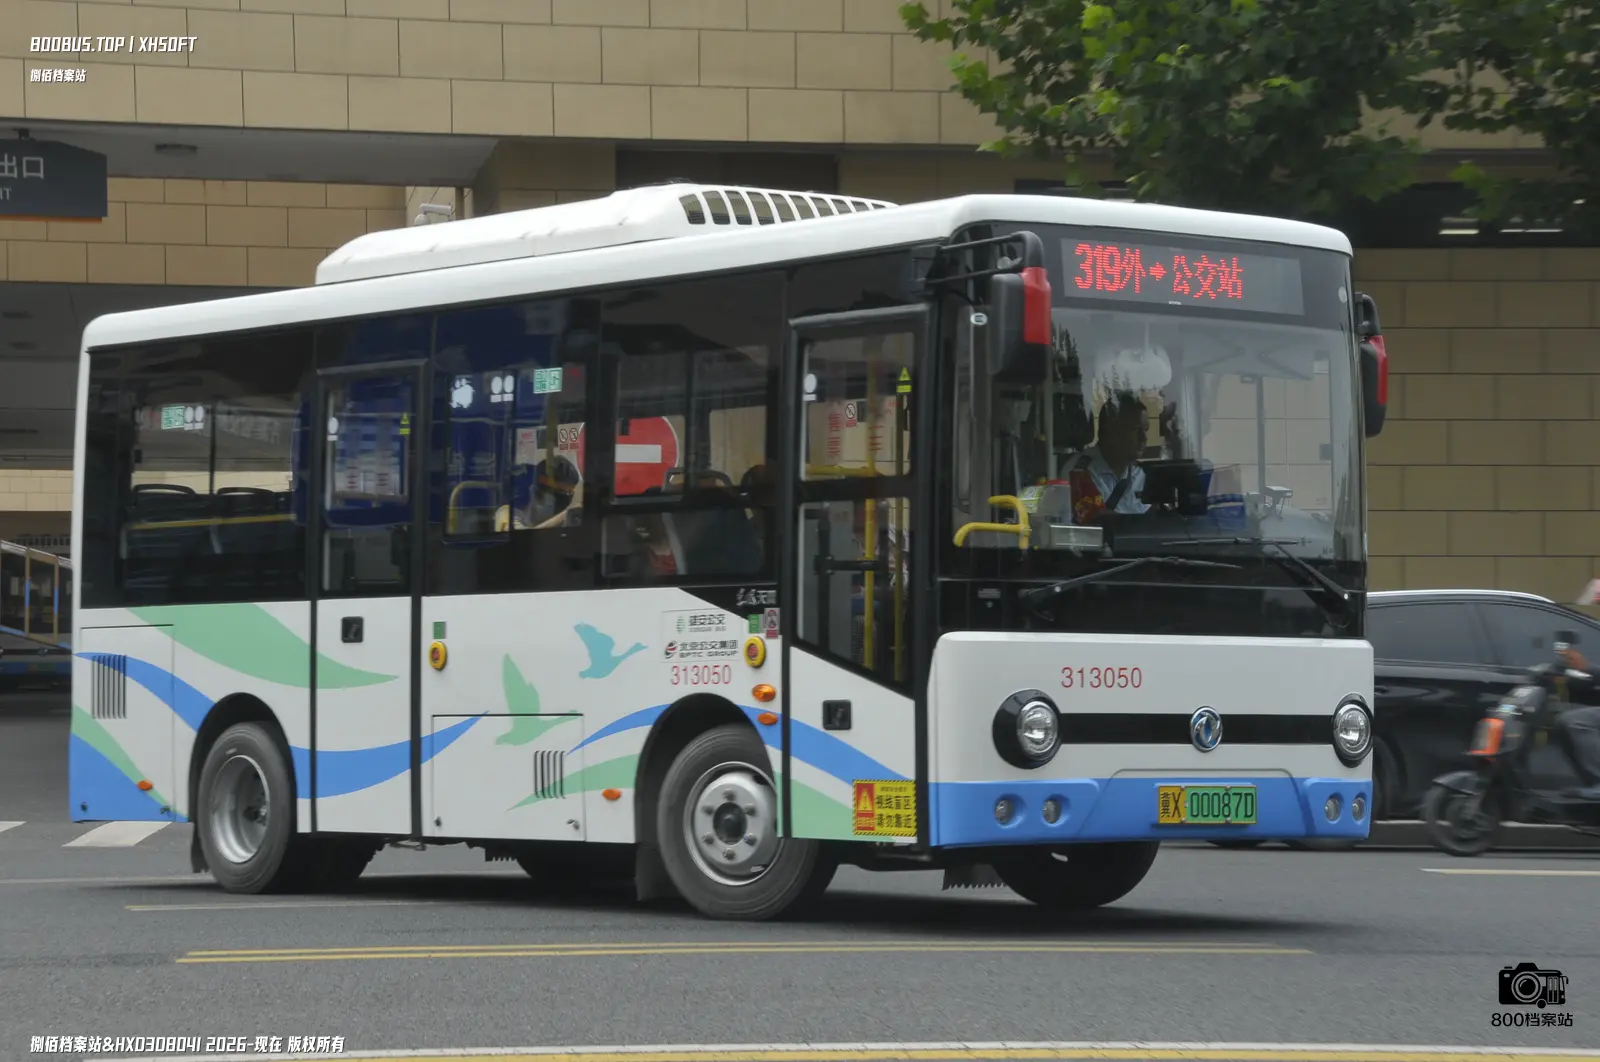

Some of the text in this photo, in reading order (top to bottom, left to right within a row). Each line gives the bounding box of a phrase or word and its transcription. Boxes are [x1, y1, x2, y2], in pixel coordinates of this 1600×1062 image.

[0, 153, 44, 180] 出口
[1074, 243, 1244, 300] 319外 公交站
[679, 640, 739, 652] 北京公交集团
[707, 649, 739, 658] GROUP
[670, 664, 732, 686] 313050
[1060, 666, 1143, 689] 313050
